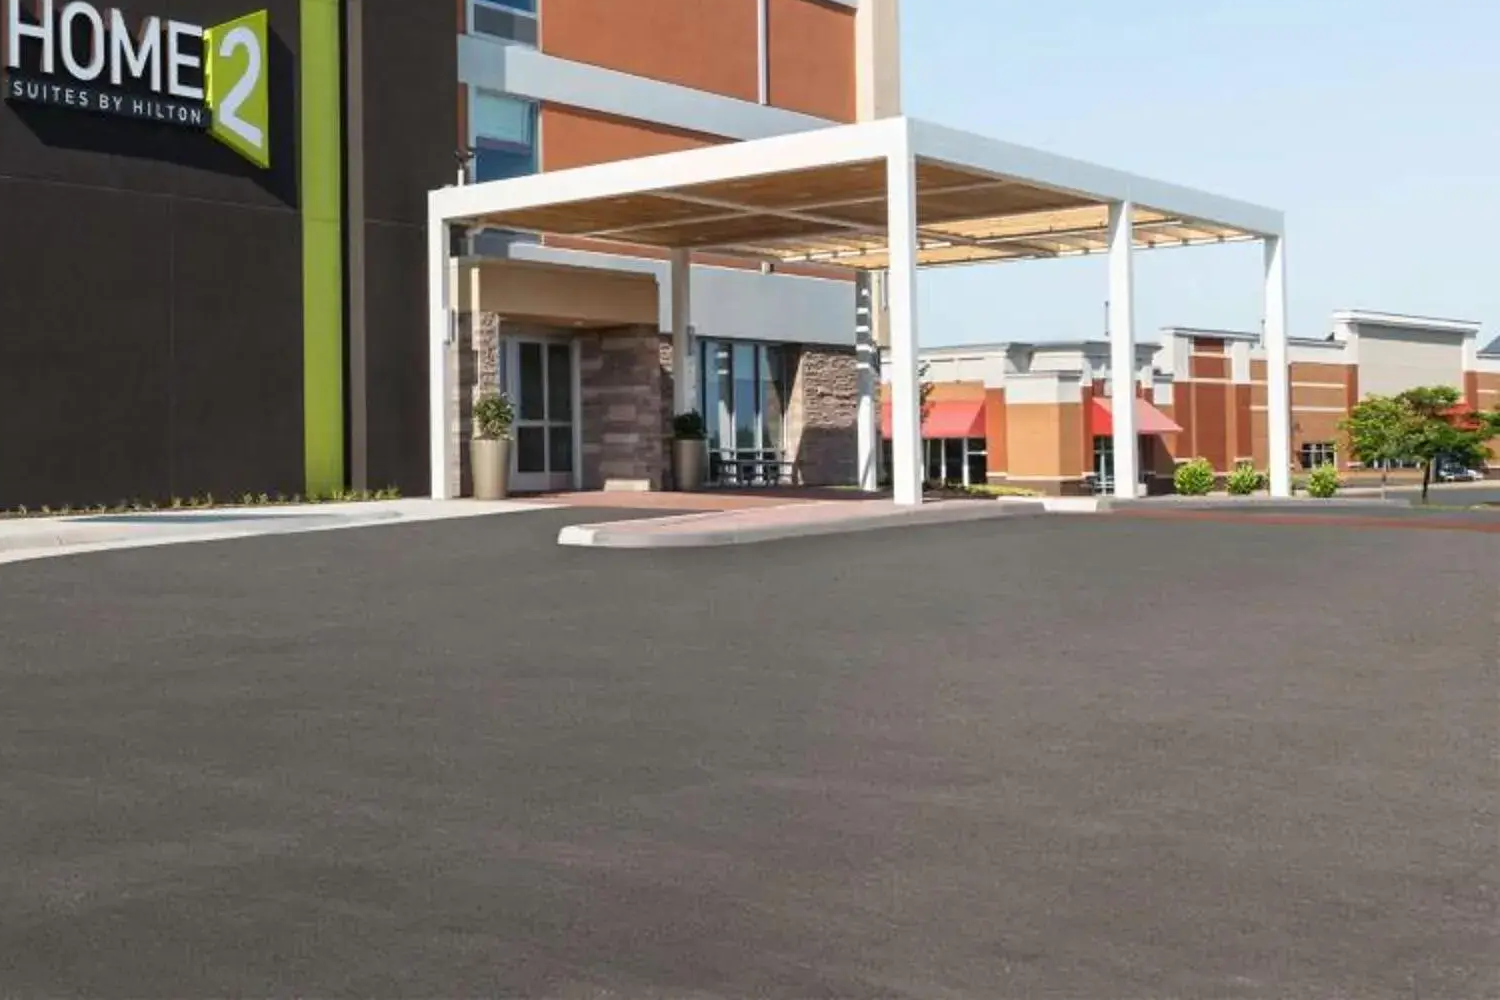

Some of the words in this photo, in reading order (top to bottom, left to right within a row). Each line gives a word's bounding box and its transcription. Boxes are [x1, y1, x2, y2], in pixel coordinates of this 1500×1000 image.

[12, 80, 89, 107] SUITES
[99, 96, 123, 113] BY
[132, 100, 202, 125] HILTON
[218, 26, 264, 149] 2
